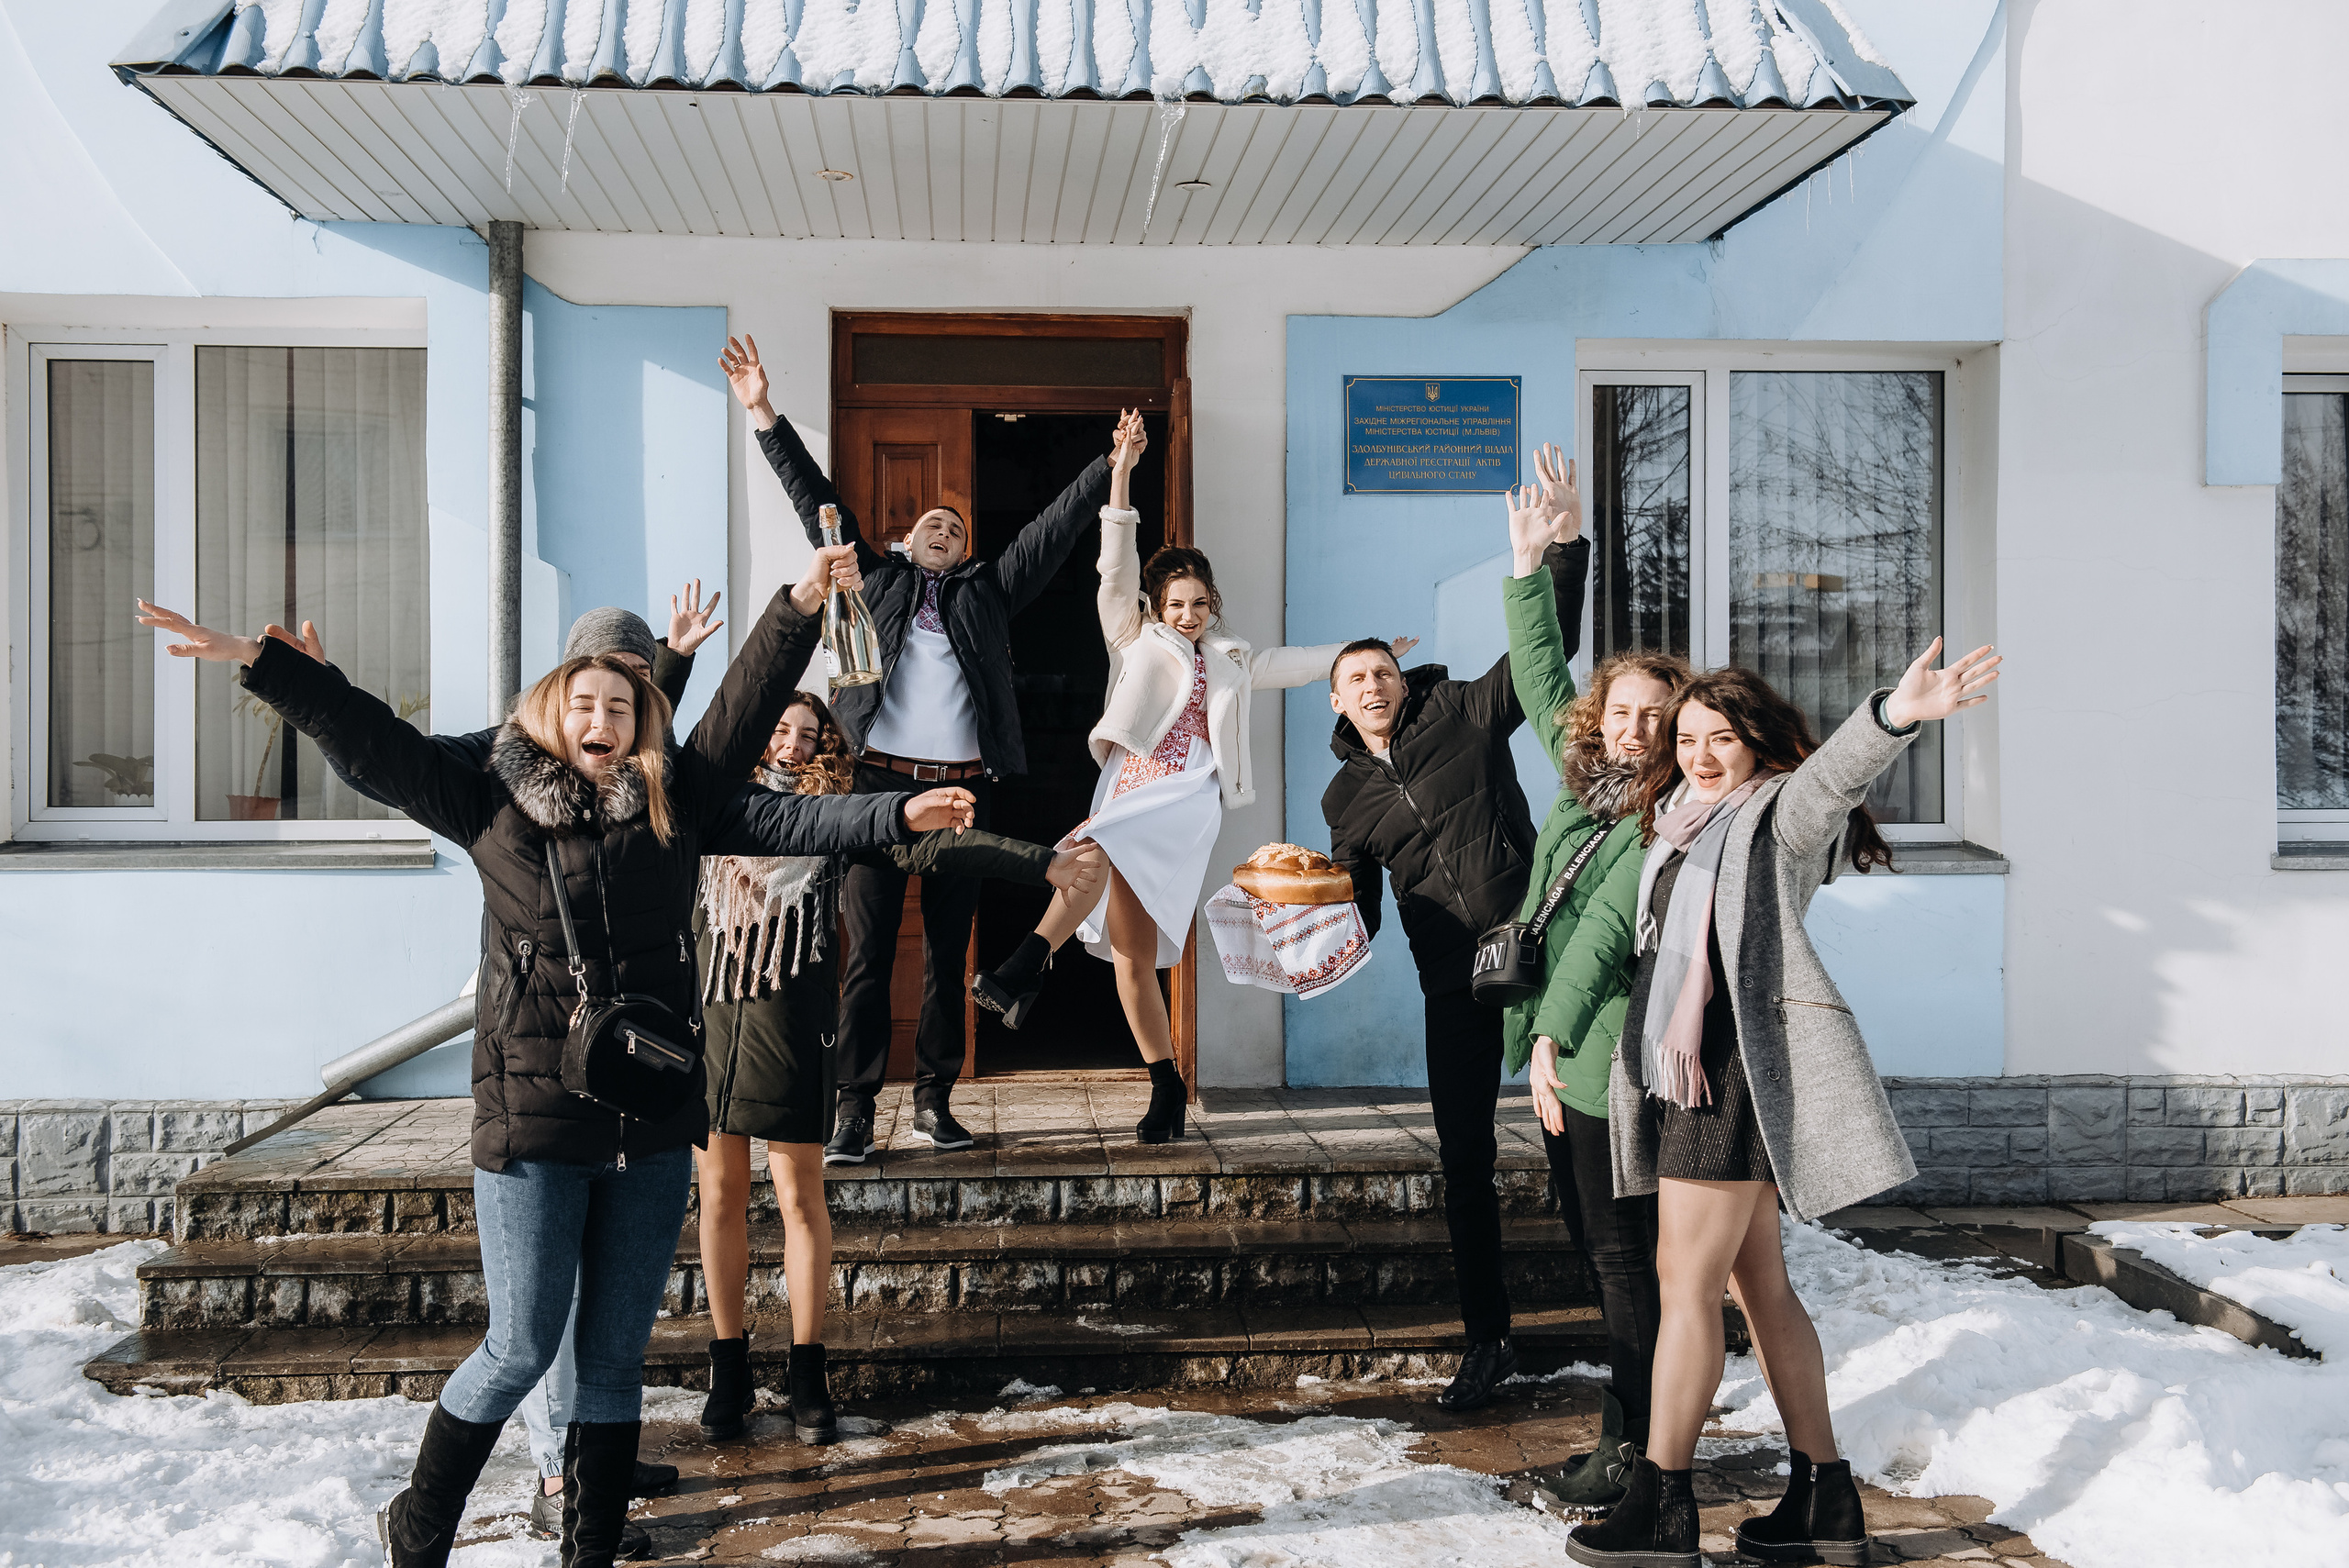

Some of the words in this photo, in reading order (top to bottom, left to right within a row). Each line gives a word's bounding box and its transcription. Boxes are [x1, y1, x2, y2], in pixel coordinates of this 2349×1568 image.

[1429, 405, 1459, 413] ЮСТИЦІЇ
[1353, 417, 1387, 425] ЗАХІДНЕ
[1365, 428, 1422, 436] МІНІСТЕРСТВА
[1425, 427, 1460, 437] ЮСТИЦІЇ
[1462, 428, 1501, 437] (М.ЛЬВІВ)
[1352, 444, 1431, 453] ЗДОЛБУНІВСЬКИЙ
[1433, 444, 1482, 453] РАЙОННИЙ
[1485, 445, 1514, 454] ВІДДІЛ
[1364, 456, 1418, 466] ДЕРЖАВНОЇ
[1419, 456, 1471, 467] РЕЄСТРАЦІЇ
[1475, 458, 1501, 467] АКТІВ
[1388, 471, 1446, 479] ЦИВІЛЬНОГО
[1448, 471, 1477, 479] СТАНУ
[1531, 885, 1564, 936] ALENCIAGA
[1564, 829, 1608, 880] BALENCIAGA
